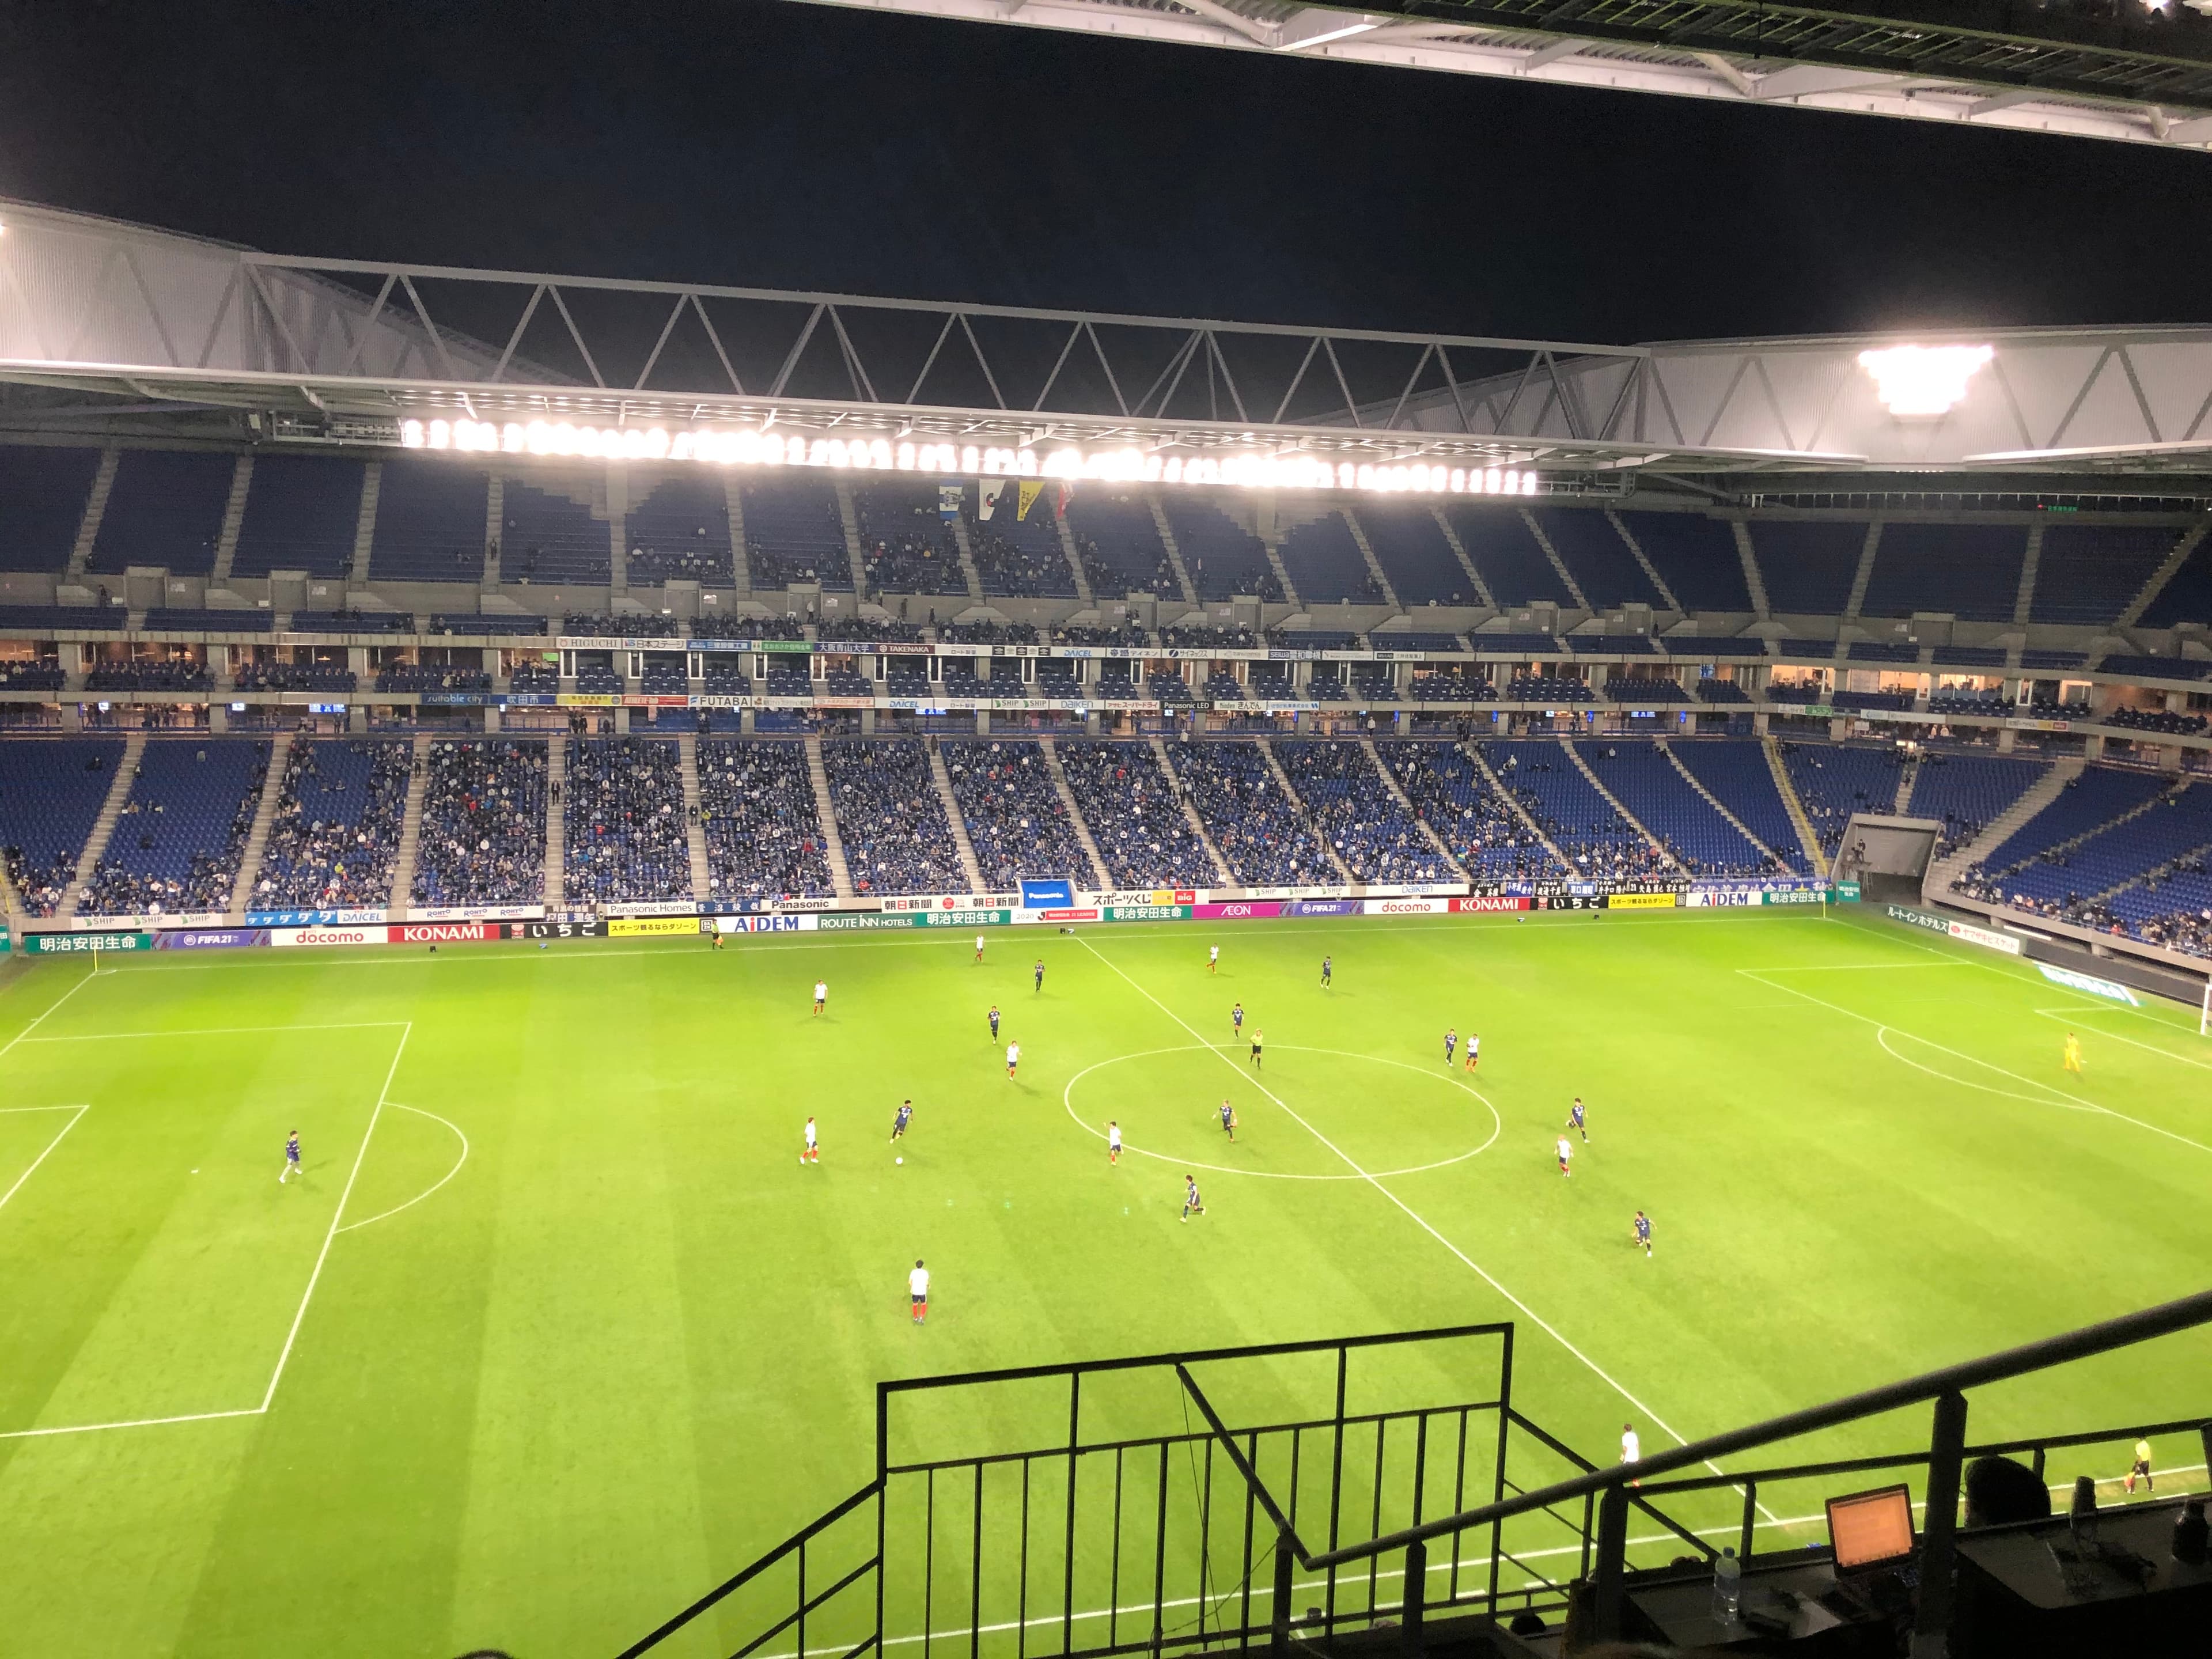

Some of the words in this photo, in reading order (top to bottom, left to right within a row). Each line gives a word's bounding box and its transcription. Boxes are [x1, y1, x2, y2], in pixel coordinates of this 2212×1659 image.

[571, 639, 617, 647] HIGUCHI
[637, 640, 684, 648] 日本ステージ
[820, 643, 869, 653] 大阪青山大学
[427, 694, 464, 703] suitable
[467, 694, 483, 704] city
[507, 695, 539, 704] 吹田市
[700, 697, 748, 706] FUTABA
[973, 897, 1018, 908] 朝日新聞
[1093, 892, 1151, 906] スポーツくじ
[1554, 897, 1600, 908] いちご
[1611, 897, 1673, 905] スポーツ観るならダゾーン
[1770, 892, 1826, 903] 明治安田生命
[611, 904, 656, 914] Panasonic
[657, 904, 692, 912] Homes
[772, 899, 829, 909] Panasonic
[885, 899, 932, 911] 朝日新聞
[1382, 901, 1431, 912] docomo
[1460, 899, 1518, 911] KONAMI
[342, 912, 381, 921] DAICEL
[427, 909, 450, 918] ROHTO
[464, 908, 487, 916] ROHTO
[500, 907, 524, 916] ROHTO
[1113, 907, 1181, 919] 明治安田生命
[821, 918, 857, 928] ROUTE
[881, 918, 912, 926] HOTELS
[927, 912, 1000, 925] 明治安田生命
[532, 923, 597, 937] いちご
[612, 923, 696, 931] スポーツ観るならダゾーン
[296, 930, 363, 943] docomo
[404, 926, 484, 940] KONAMI
[1963, 927, 2015, 948] ヤマザキビスケット
[40, 936, 136, 951] 明治安田生命
